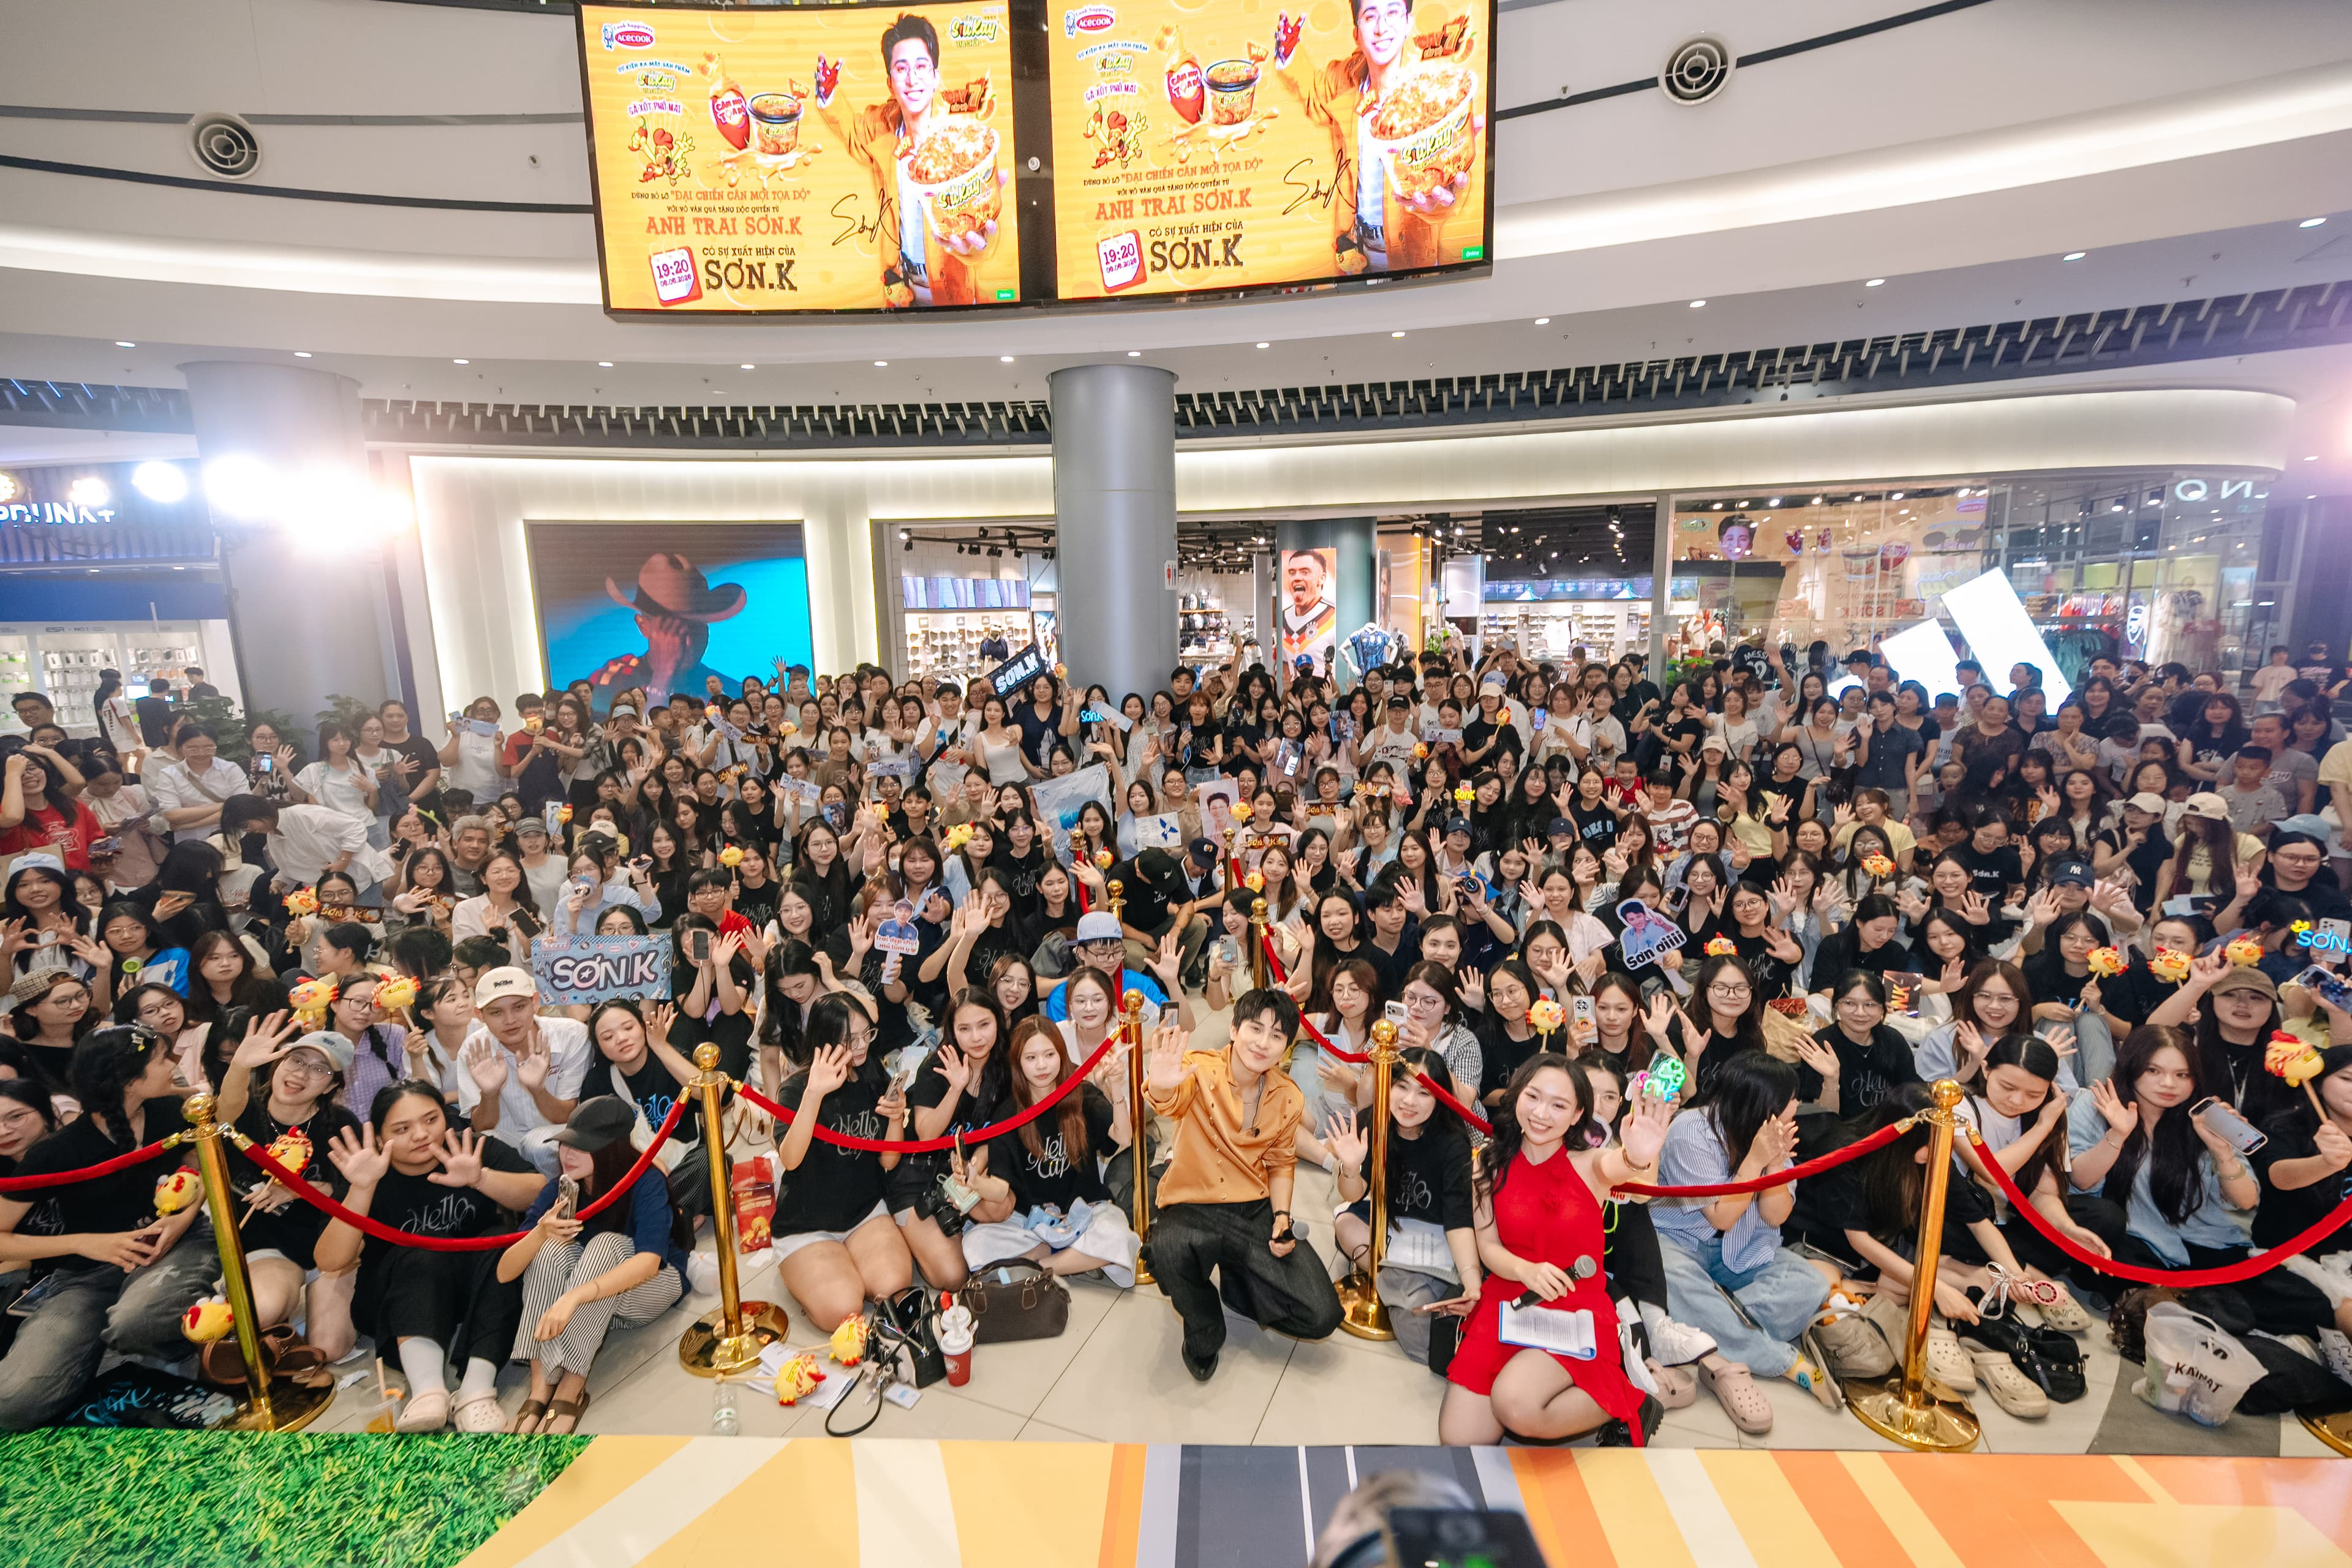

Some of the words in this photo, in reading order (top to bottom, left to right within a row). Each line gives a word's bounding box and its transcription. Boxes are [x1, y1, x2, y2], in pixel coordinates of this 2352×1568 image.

[668, 104, 681, 113] MAI
[1095, 200, 1133, 221] ANH
[1141, 195, 1185, 216] TRAI
[1194, 187, 1252, 213] SƠN.K
[646, 216, 685, 235] ANH
[693, 217, 737, 235] TRAI
[745, 214, 802, 235] SƠN.K
[1149, 227, 1162, 237] CÓ
[1165, 226, 1176, 238] SỰ
[1178, 222, 1200, 235] XUẤT
[1203, 222, 1222, 235] HIỆN
[1226, 219, 1243, 231] CỦA
[703, 245, 715, 255] CÓ
[718, 246, 729, 258] SỰ
[732, 243, 752, 256] XUẤT
[756, 246, 775, 258] HIỆN
[778, 244, 796, 255] CỦA
[1104, 243, 1135, 265] 19:20
[1150, 234, 1243, 273] SƠN.K
[656, 260, 688, 279] 19:20
[704, 258, 797, 292] SƠN.K
[1744, 650, 1769, 662] MESSI
[995, 652, 1040, 695] SƠN.K
[891, 935, 903, 946] đẹp
[1627, 949, 1656, 969] Sơn
[2174, 1361, 2223, 1394] KAINAT
